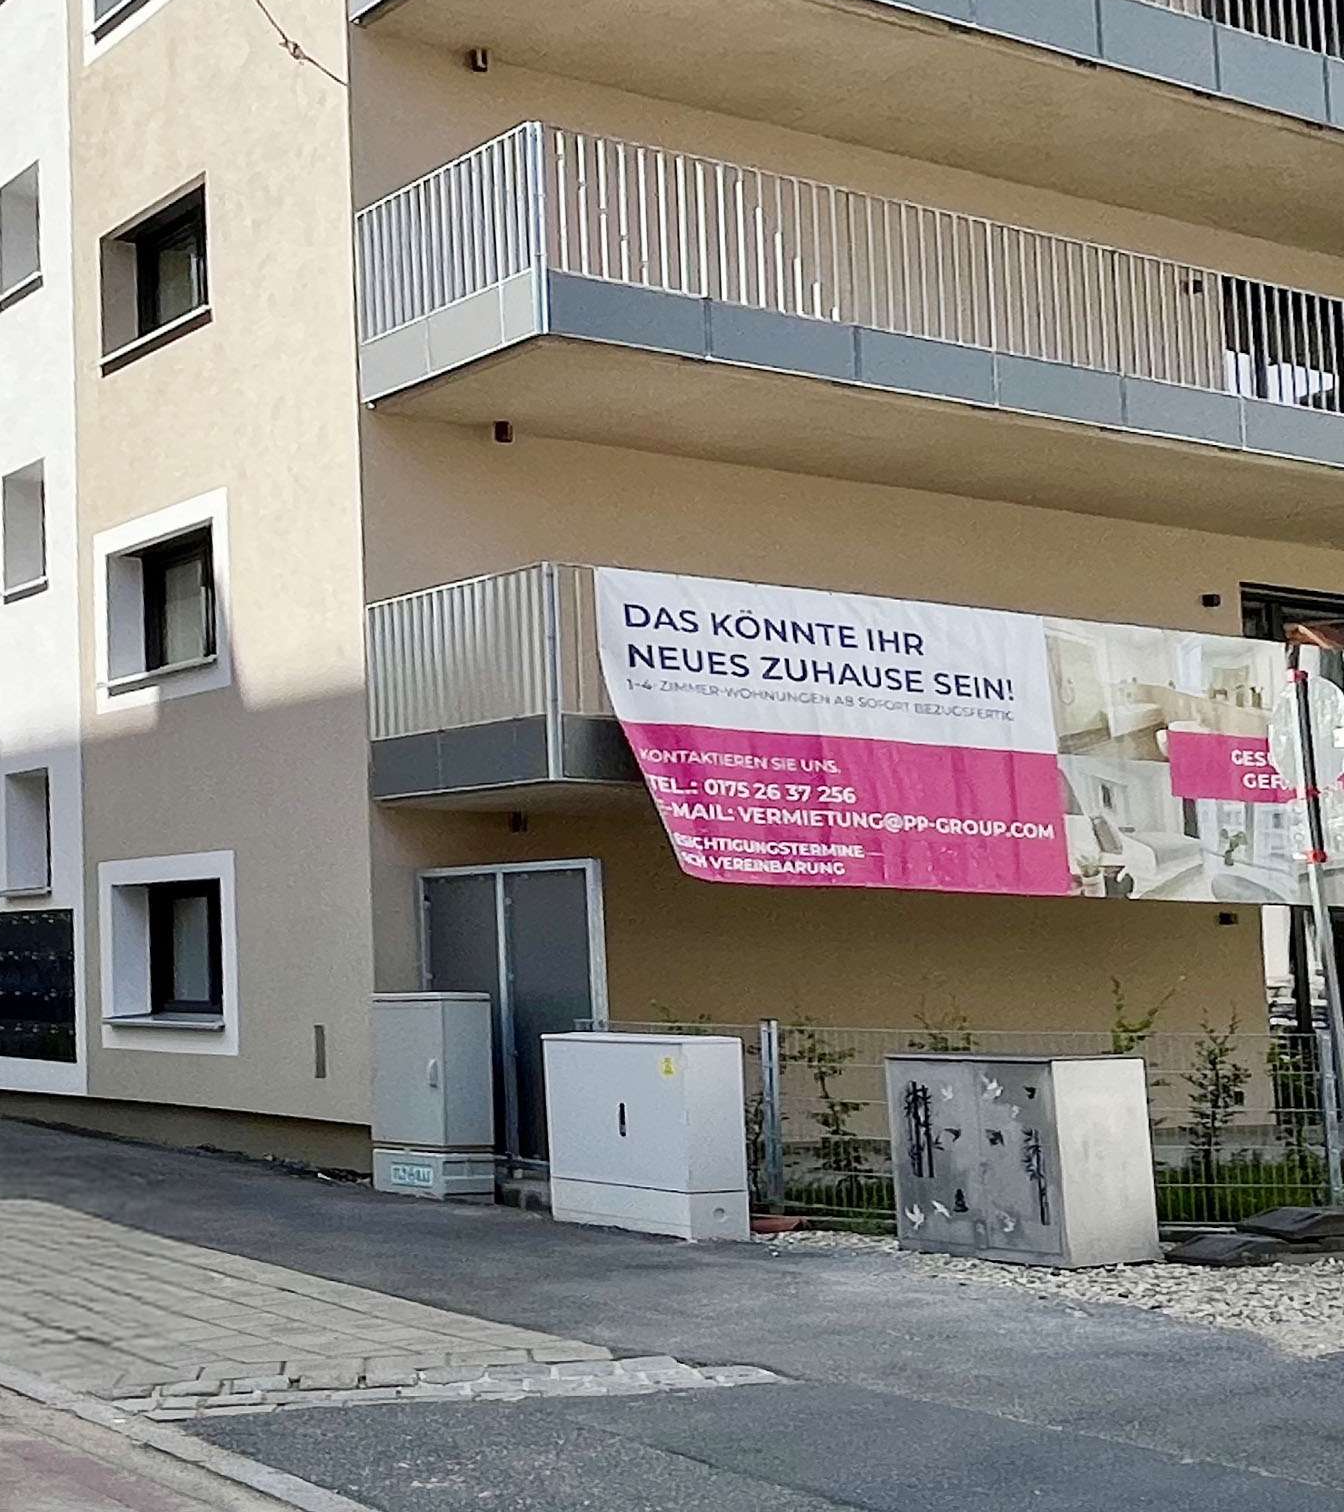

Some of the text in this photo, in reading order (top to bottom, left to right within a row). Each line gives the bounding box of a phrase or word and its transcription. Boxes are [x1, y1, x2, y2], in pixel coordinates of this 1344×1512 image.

[624, 603, 924, 656] DAS KÖNNTE IHR
[628, 643, 1014, 701] NEUES ZUHAUSE SEIN!
[833, 694, 854, 707] AB
[771, 757, 797, 771] SIE
[1231, 749, 1275, 767] GES
[704, 779, 749, 799] 0175
[753, 783, 782, 801] 26
[784, 784, 812, 803] 37
[817, 786, 856, 804] 256
[737, 807, 1055, 839] VERMIETUNG@PP-GROUP.COM
